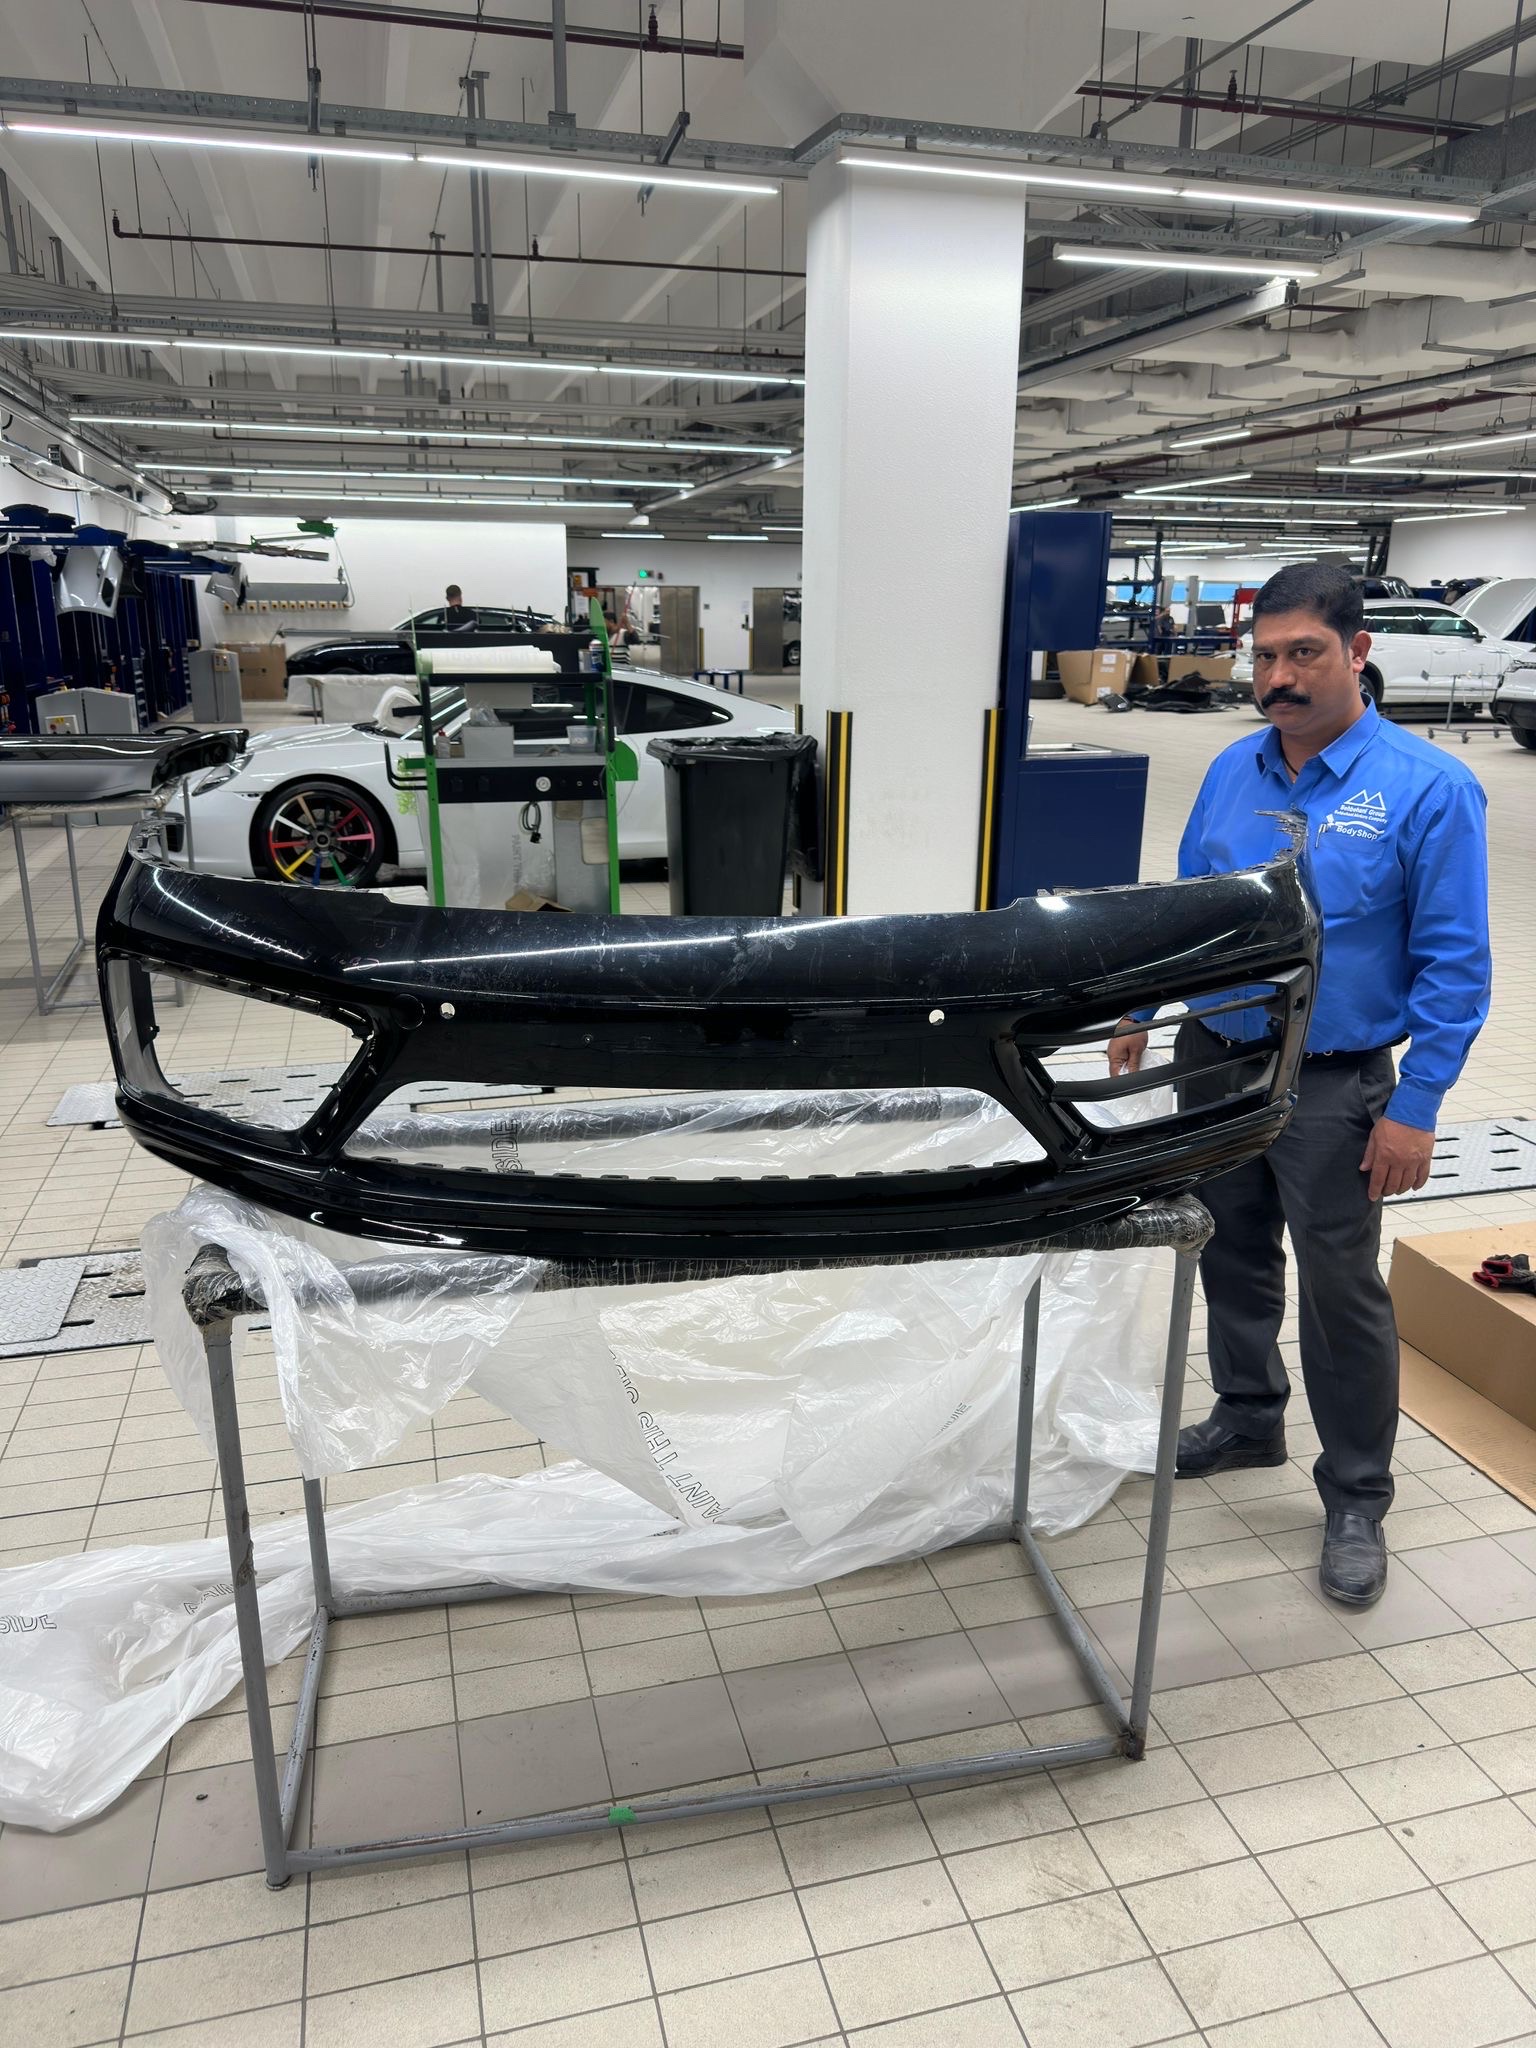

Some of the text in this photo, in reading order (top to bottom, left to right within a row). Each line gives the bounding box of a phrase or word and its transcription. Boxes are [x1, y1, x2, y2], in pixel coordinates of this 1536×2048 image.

[1369, 809, 1386, 818] Group
[1336, 825, 1378, 841] BodyShop
[490, 1119, 523, 1173] SIDE
[666, 1473, 731, 1523] AINT
